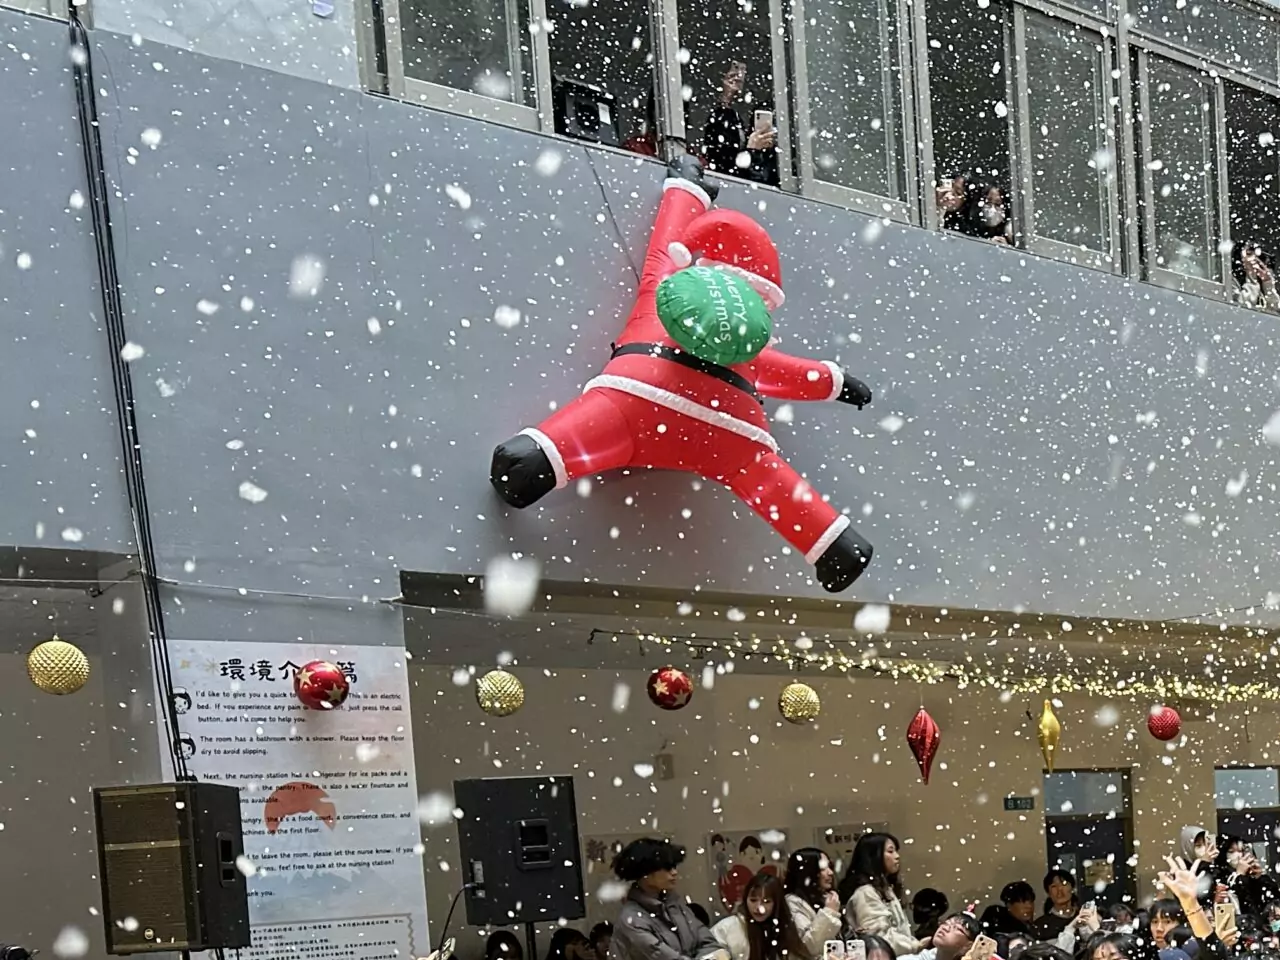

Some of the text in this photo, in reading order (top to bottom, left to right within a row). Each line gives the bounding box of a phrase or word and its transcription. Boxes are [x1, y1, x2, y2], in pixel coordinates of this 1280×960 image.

[720, 272, 748, 322] Merry
[695, 267, 732, 341] Christmas
[219, 658, 358, 684] 環境介篇
[196, 690, 206, 698] I'd
[208, 690, 220, 698] like
[232, 691, 247, 700] give
[248, 692, 261, 700] you
[270, 691, 288, 700] quick
[238, 703, 272, 712] experience
[288, 703, 300, 712] pain
[348, 704, 361, 713] just
[362, 705, 379, 713] press
[278, 716, 292, 725] help
[362, 735, 376, 743] keep
[390, 734, 405, 742] floor
[200, 748, 212, 756] dry
[242, 748, 269, 756] slipping.
[370, 770, 388, 779] packs
[278, 827, 288, 835] the
[313, 850, 332, 858] please
[348, 861, 371, 869] nursing
